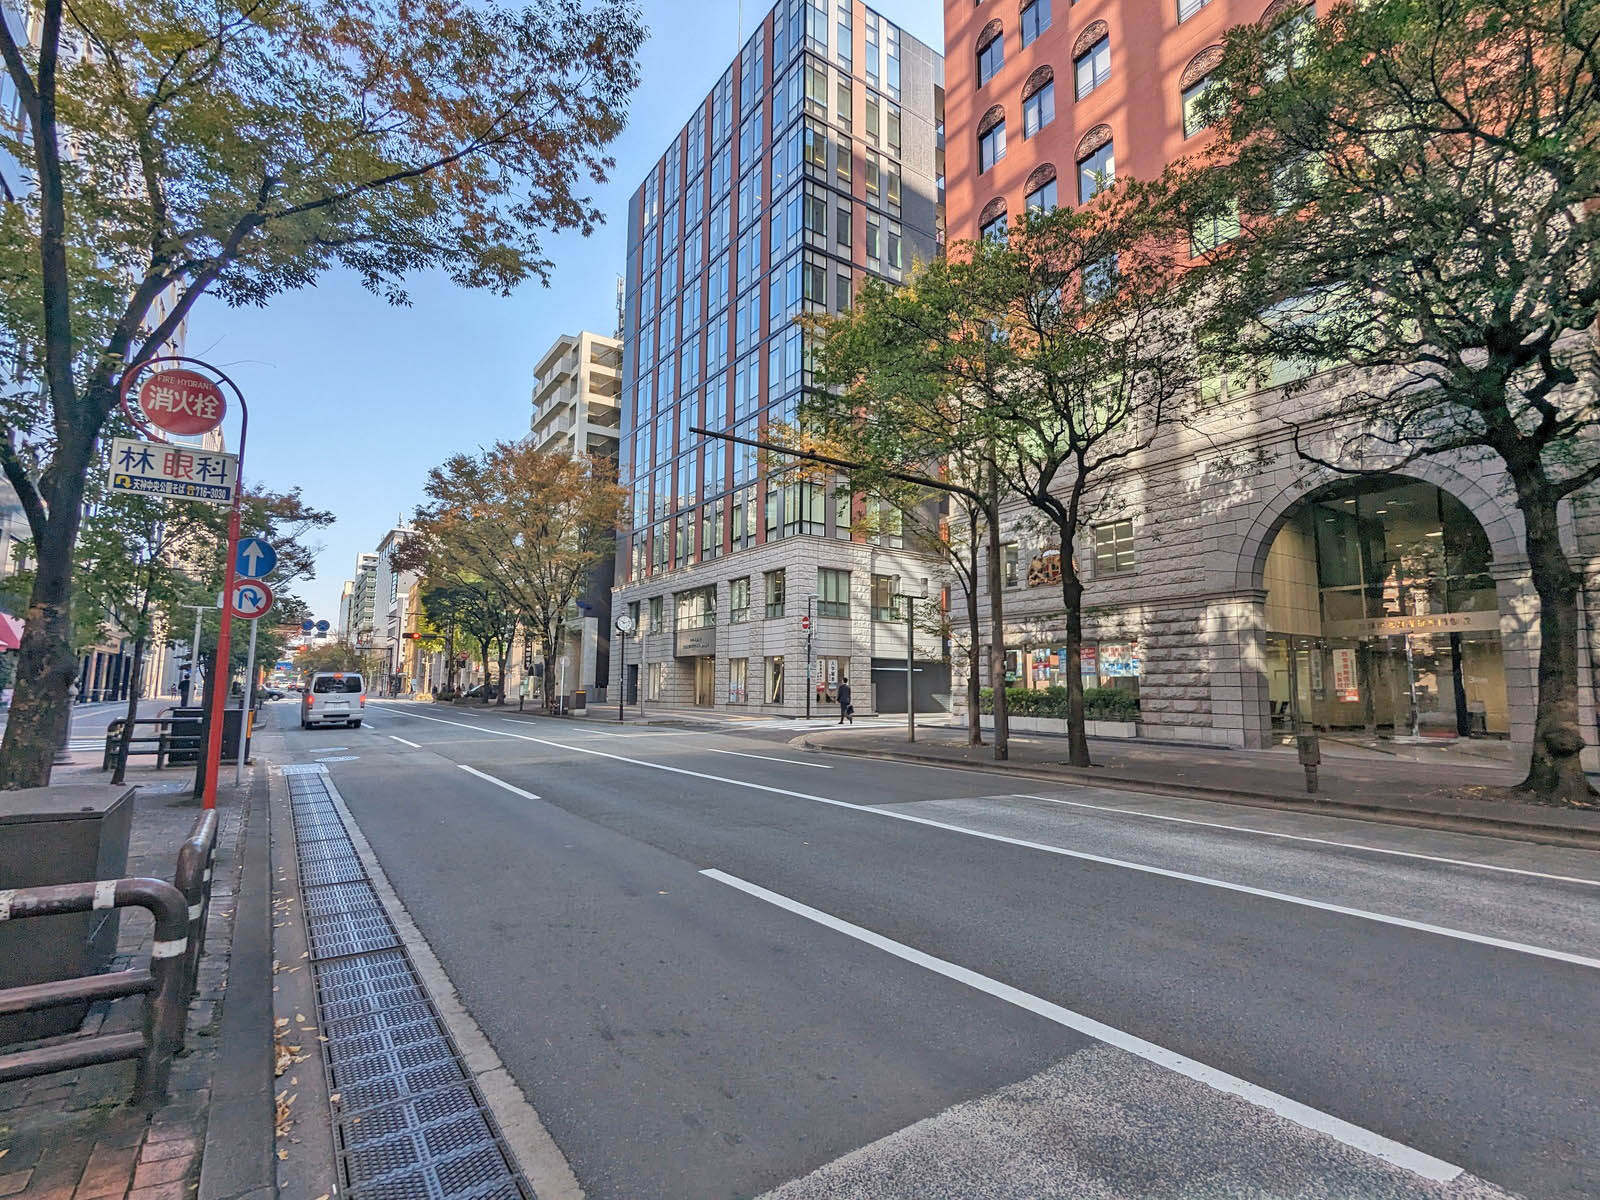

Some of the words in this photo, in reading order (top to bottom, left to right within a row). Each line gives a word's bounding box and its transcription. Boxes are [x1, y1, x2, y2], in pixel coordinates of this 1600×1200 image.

[157, 374, 175, 385] FIRE
[177, 377, 213, 391] HYDRANT
[147, 385, 220, 420] 消火栓
